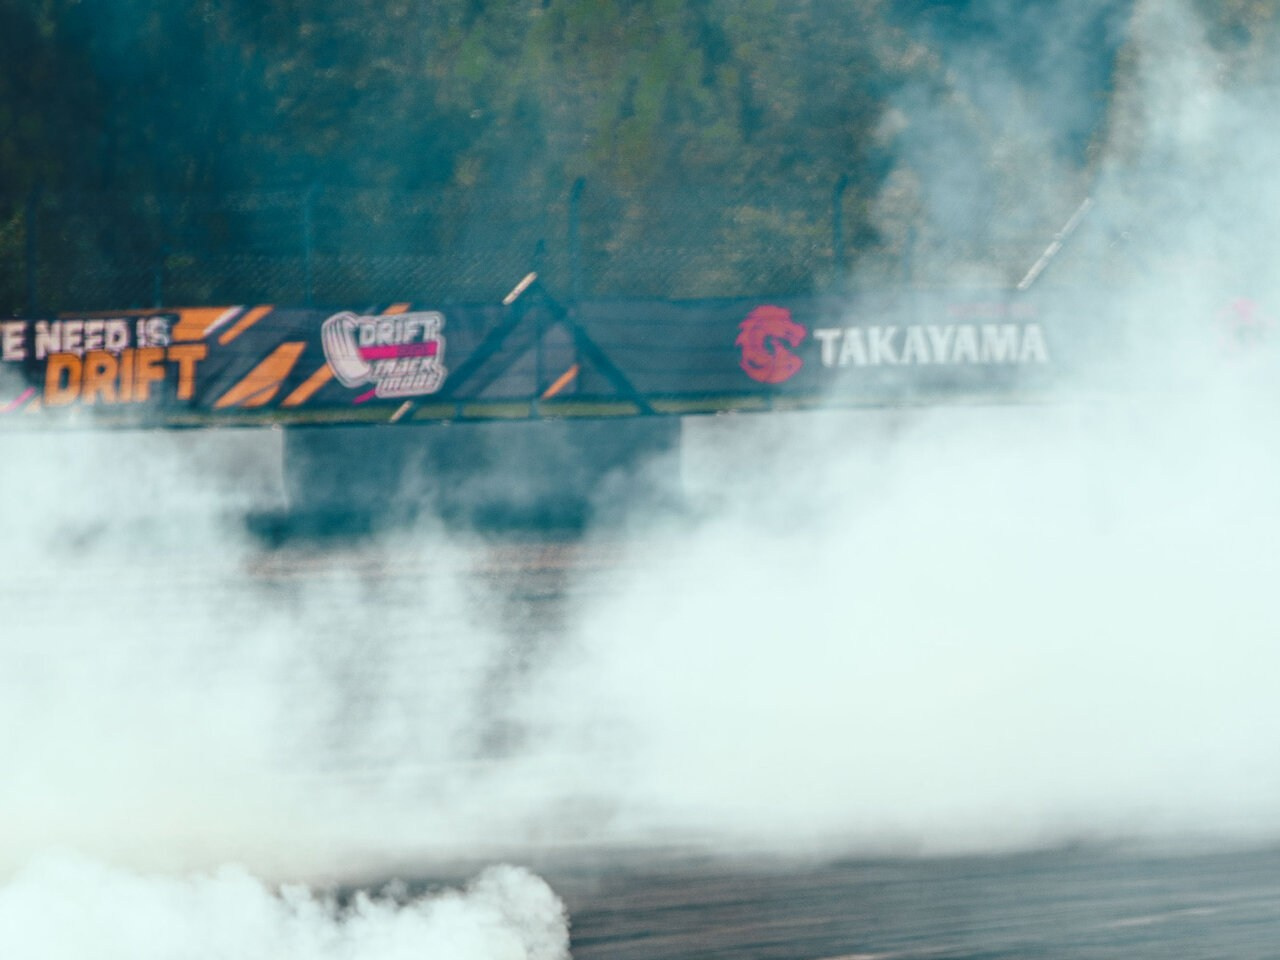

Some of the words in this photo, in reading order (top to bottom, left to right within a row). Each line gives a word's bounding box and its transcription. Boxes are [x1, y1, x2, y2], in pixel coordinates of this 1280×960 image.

[35, 319, 130, 360] NEED
[136, 317, 170, 347] IS
[359, 319, 437, 346] DRIFT
[813, 323, 1050, 368] TAKAYAMA
[44, 345, 208, 407] DRIFT
